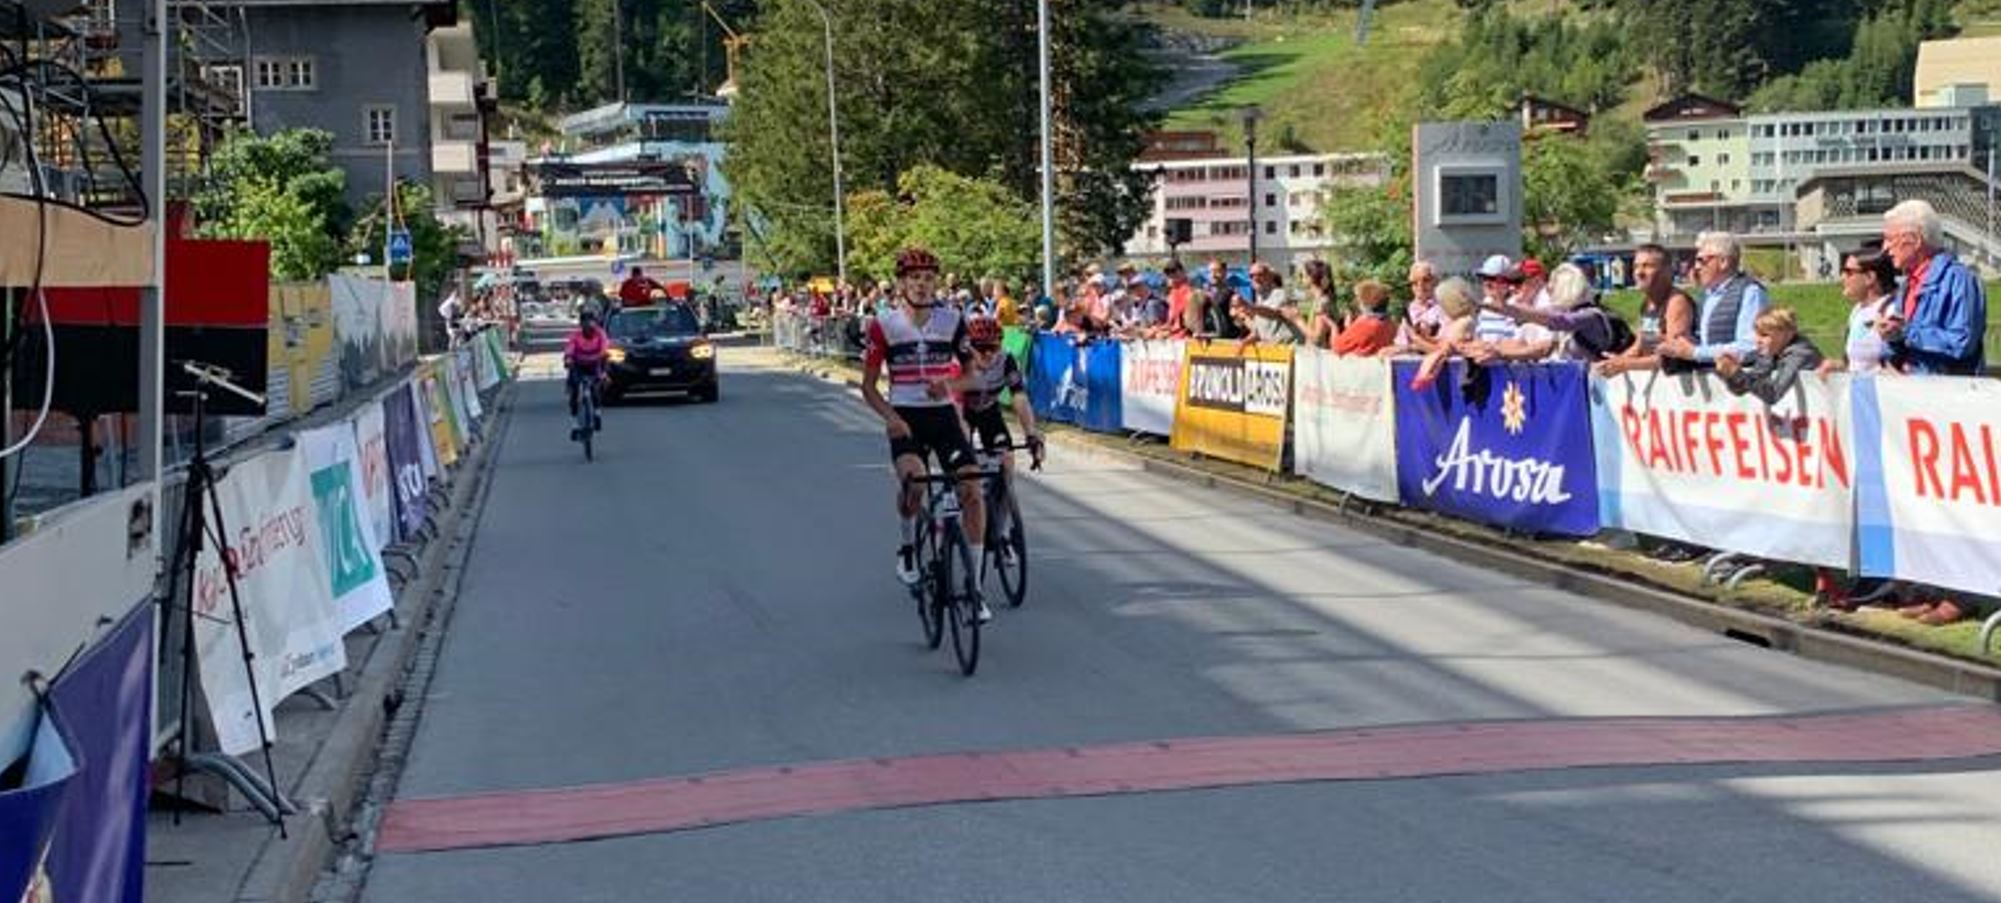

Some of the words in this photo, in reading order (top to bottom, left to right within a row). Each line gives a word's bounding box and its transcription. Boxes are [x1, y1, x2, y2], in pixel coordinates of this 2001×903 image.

[1422, 415, 1572, 504] Arosa
[1621, 404, 1850, 489] RAIFFEISEN
[1906, 419, 2001, 506] RAI
